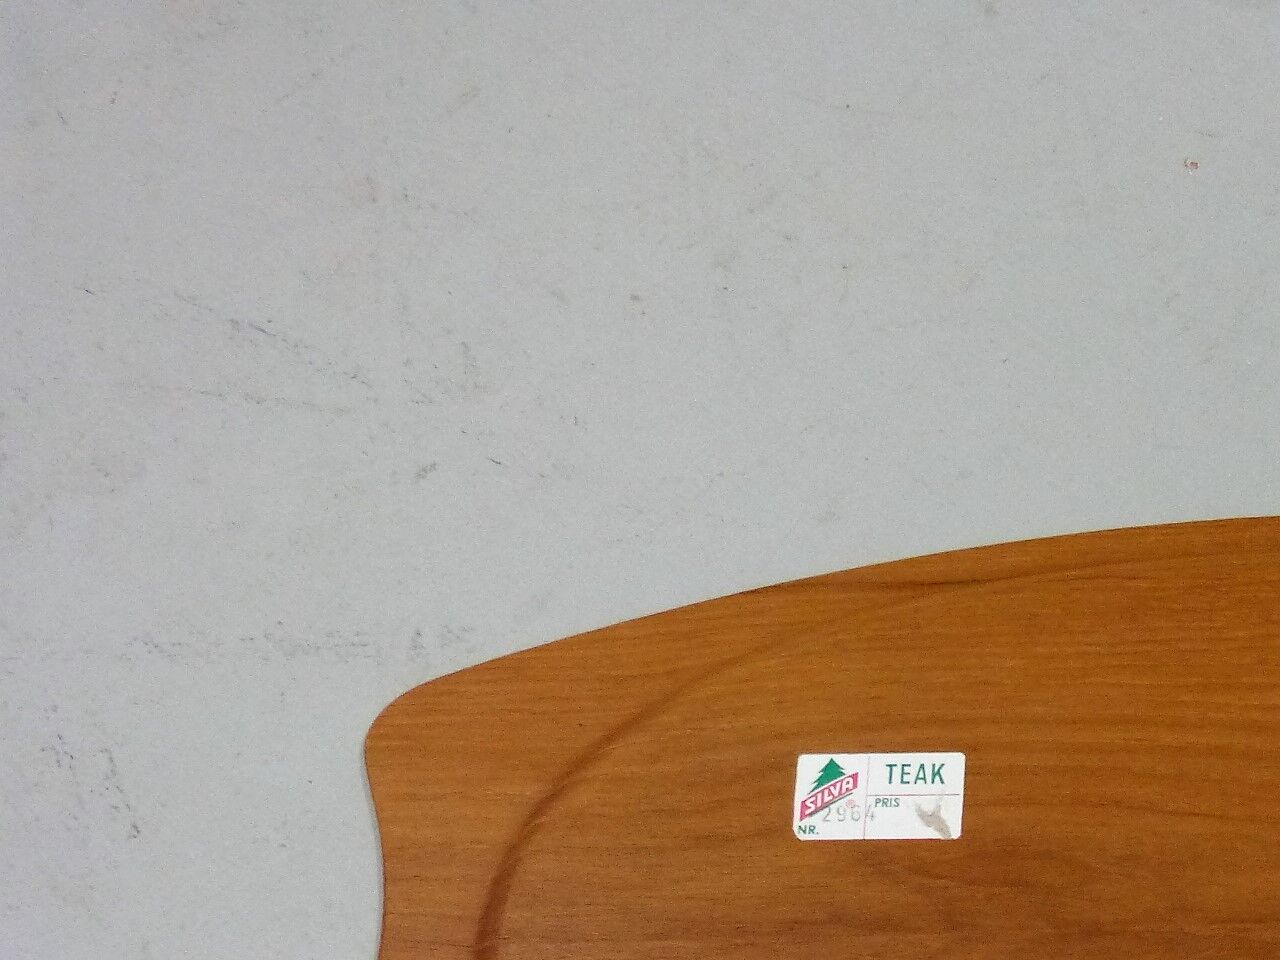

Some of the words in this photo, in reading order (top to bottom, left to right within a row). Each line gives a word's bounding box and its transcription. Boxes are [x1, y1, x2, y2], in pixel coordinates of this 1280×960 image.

[886, 763, 945, 785] TEAK
[803, 777, 855, 816] SILVA
[874, 798, 900, 808] PRIS
[798, 825, 819, 835] NR.
[822, 804, 875, 823] 2964
